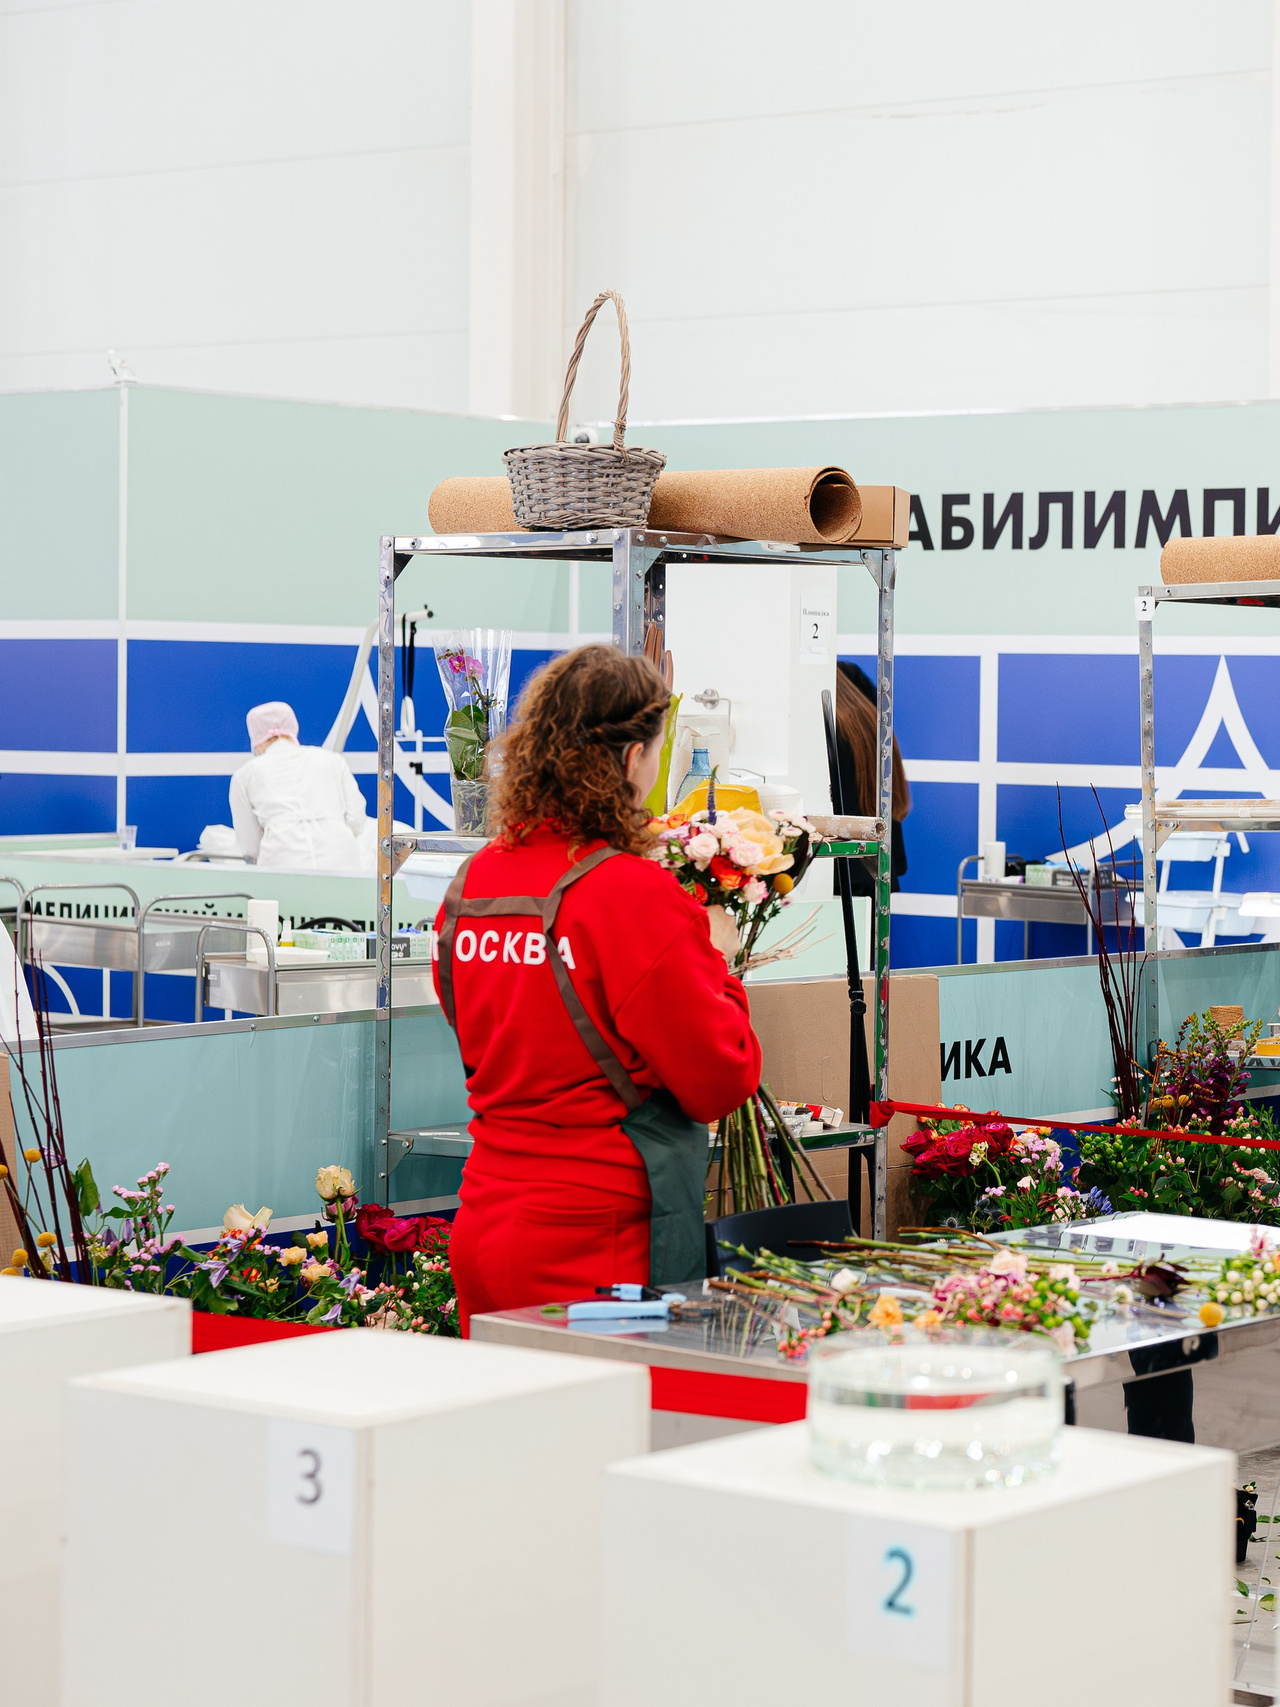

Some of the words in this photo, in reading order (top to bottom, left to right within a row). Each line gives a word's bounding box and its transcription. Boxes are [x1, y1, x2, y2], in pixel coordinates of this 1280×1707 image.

[1141, 600, 1147, 611] 2
[812, 622, 819, 639] 2
[432, 930, 576, 970] ОСКВА
[295, 1447, 323, 1506] 3
[885, 1545, 914, 1617] 2
